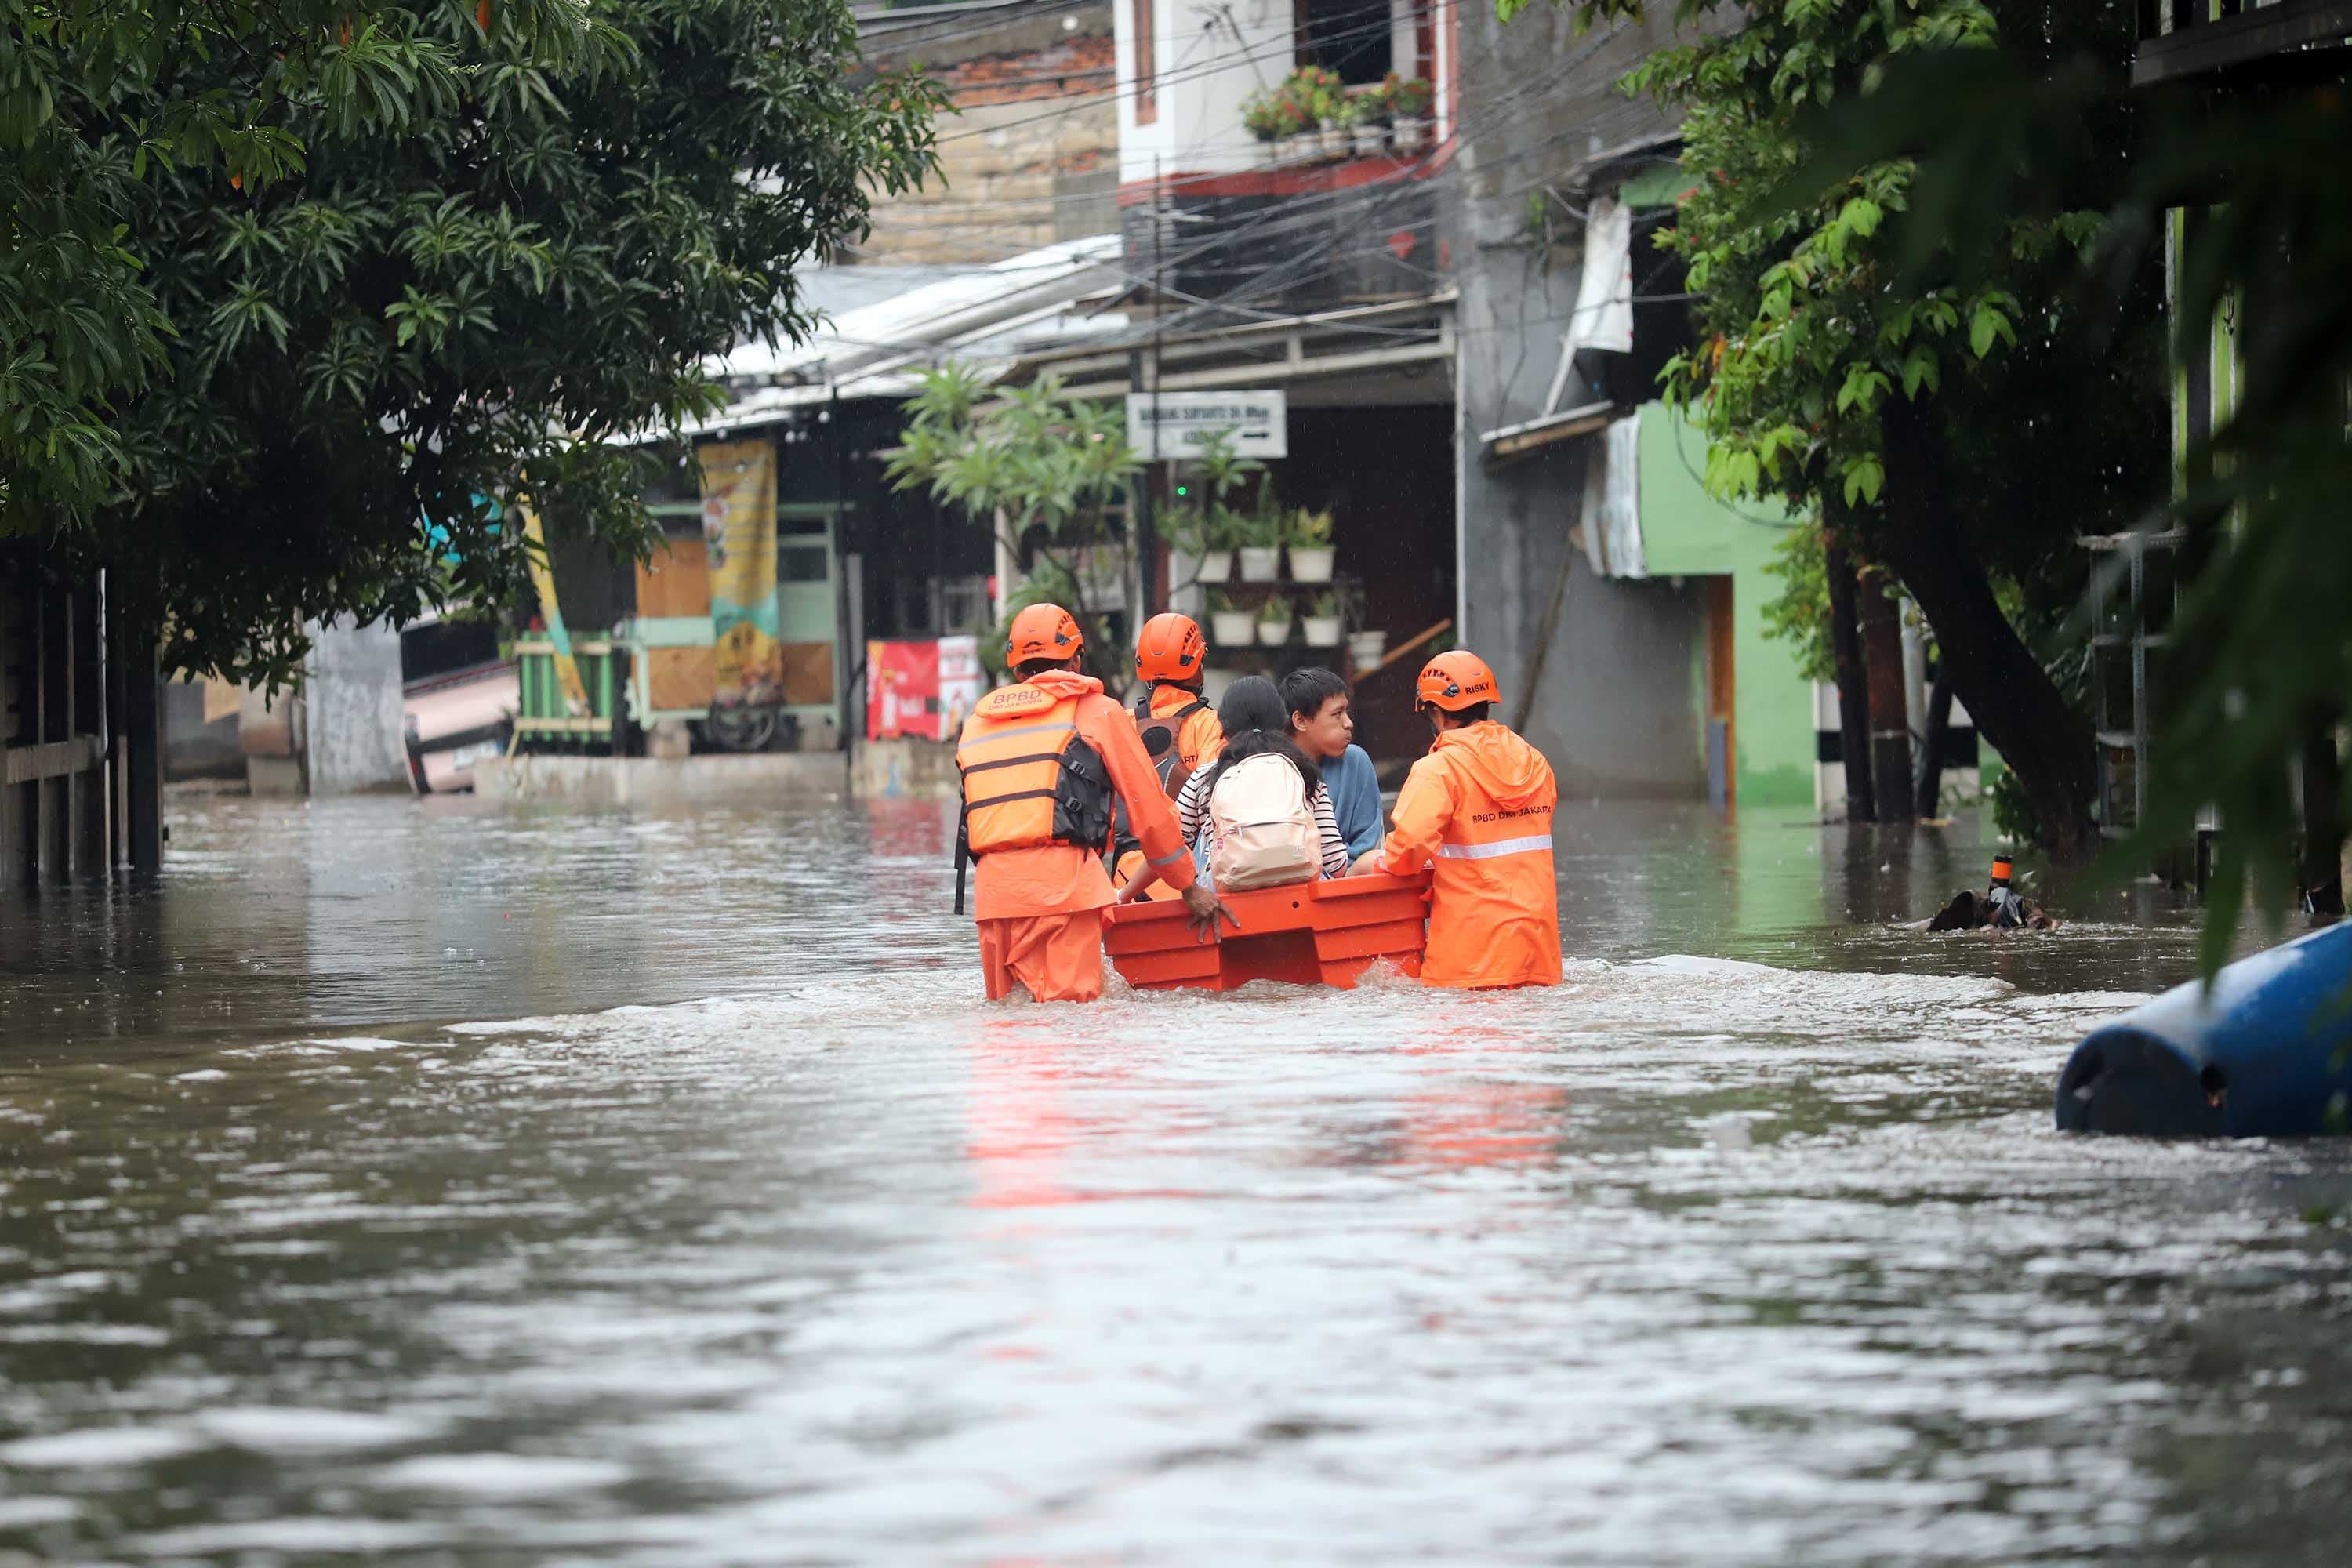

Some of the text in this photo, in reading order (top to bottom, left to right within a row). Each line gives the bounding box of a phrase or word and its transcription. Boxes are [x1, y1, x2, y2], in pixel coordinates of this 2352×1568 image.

[1465, 681, 1490, 695] RISKY
[993, 690, 1042, 704] BPBD
[1472, 813, 1496, 823] BPBD
